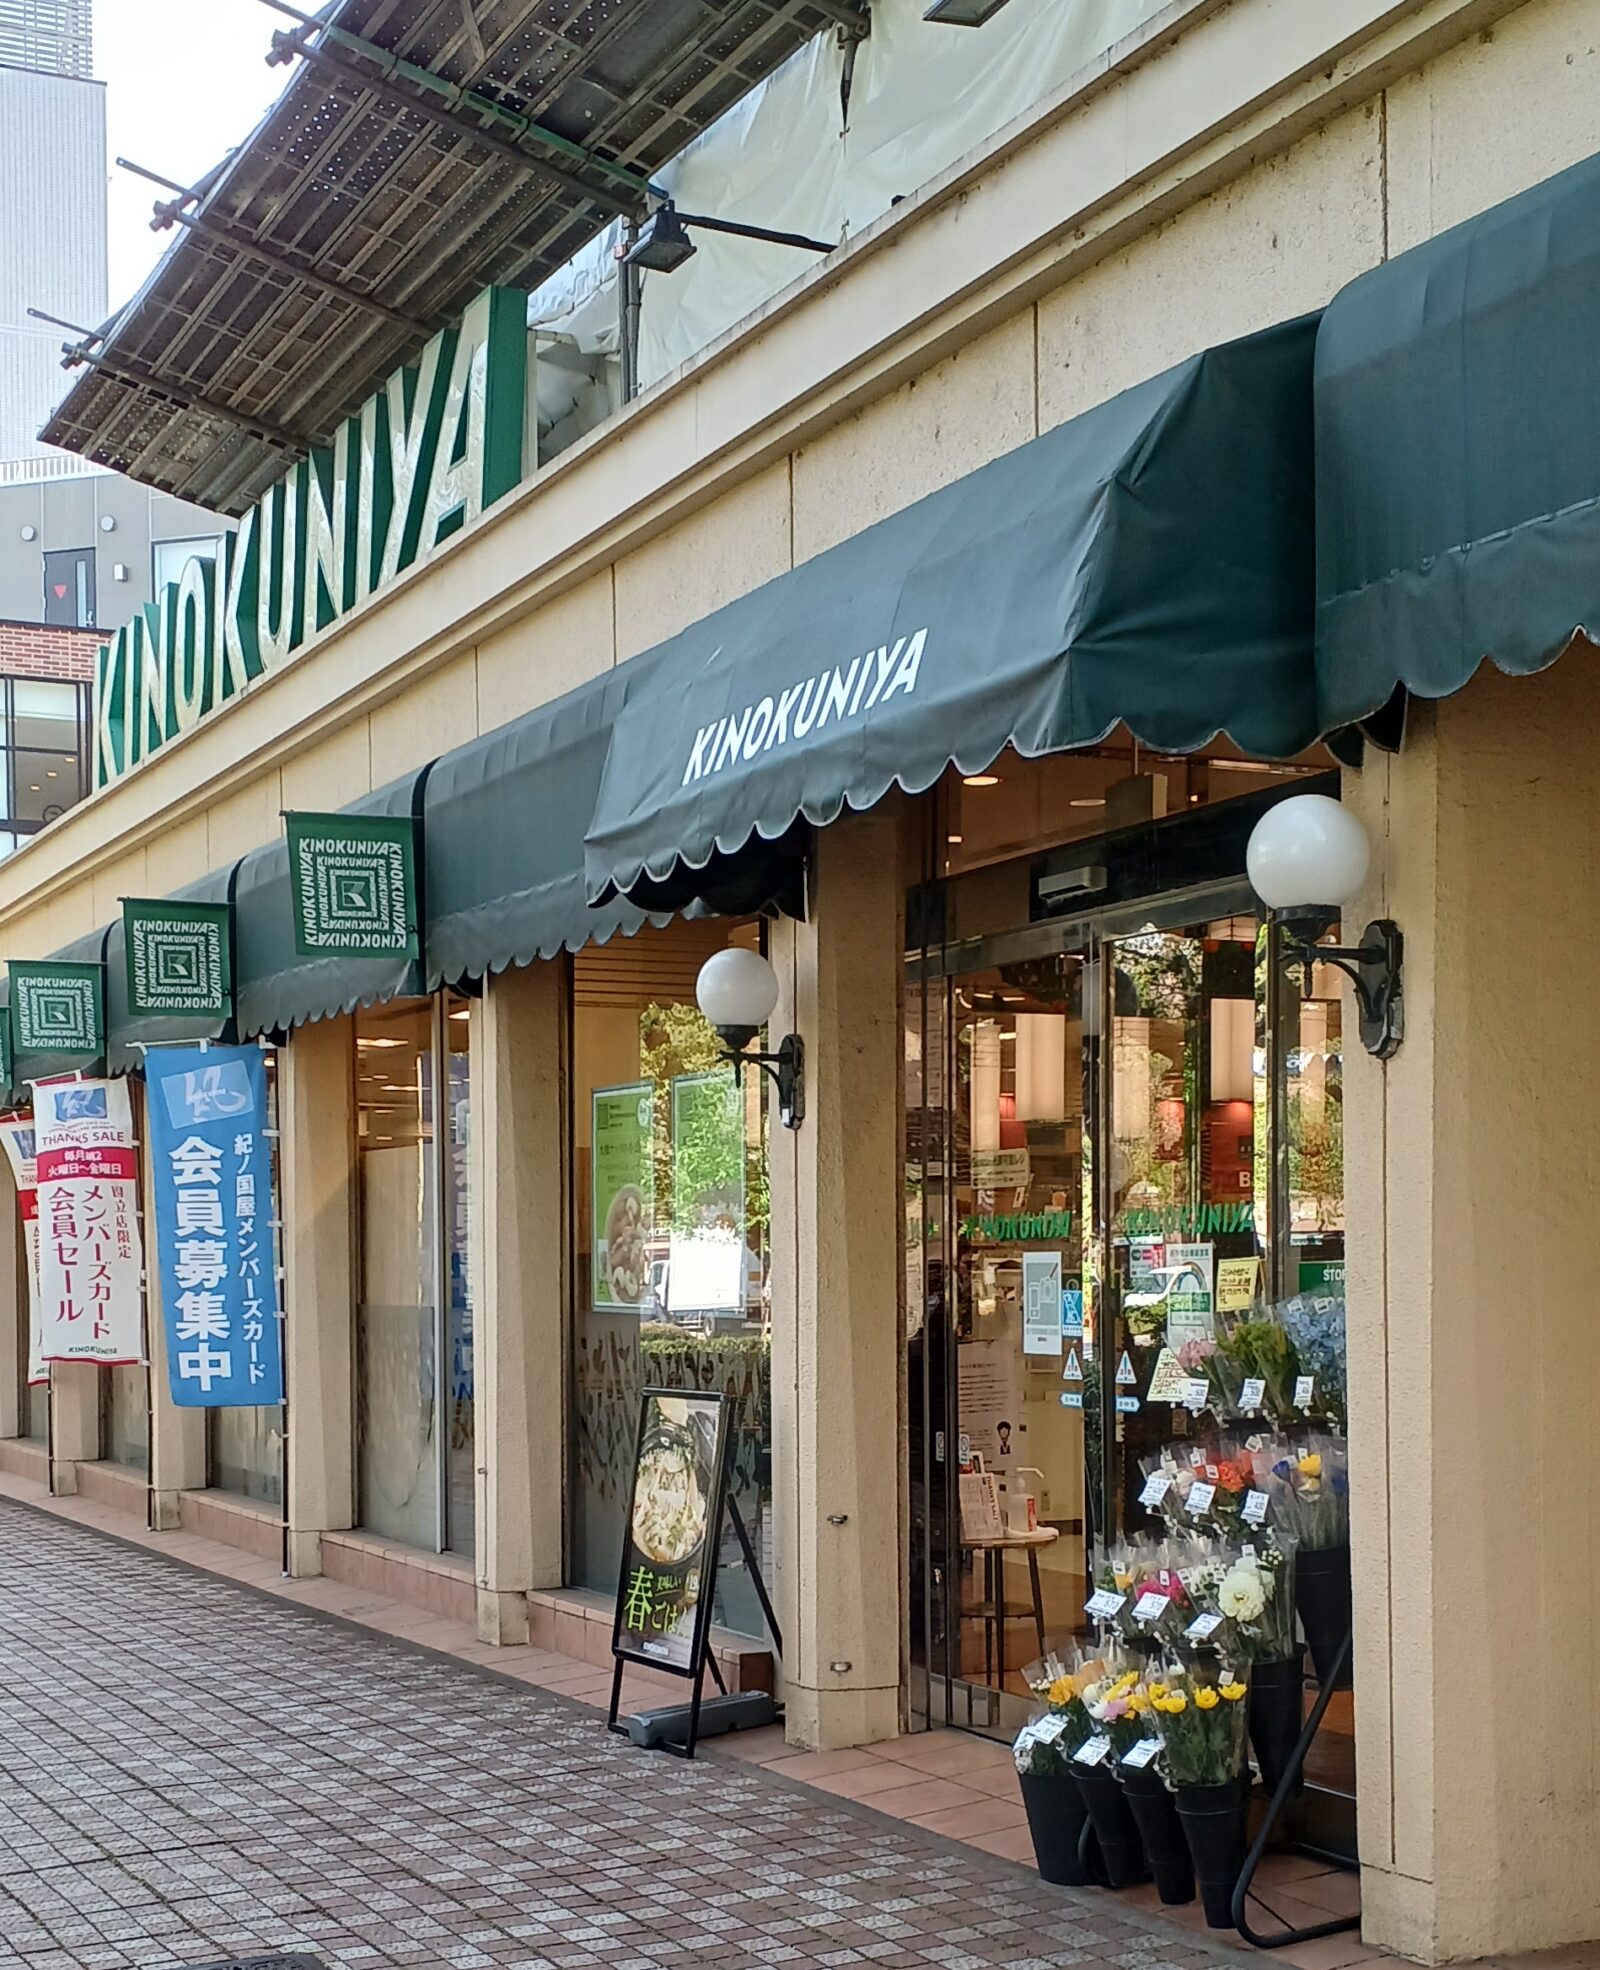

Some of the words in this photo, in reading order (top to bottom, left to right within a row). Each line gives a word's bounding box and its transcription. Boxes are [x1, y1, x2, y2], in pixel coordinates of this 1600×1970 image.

[93, 285, 512, 790] KINOKUNIYA
[682, 627, 928, 787] KINOKUNIYA
[299, 838, 390, 856] KINOKUNIYA
[300, 852, 318, 946] KINOKUNIYA
[388, 842, 406, 936] KINOKUNIYA
[133, 920, 209, 934] KINOKUNIYA
[207, 922, 222, 997] KINOKUNIYA
[317, 932, 407, 949] KINOKUNIYA
[17, 977, 84, 988] KINOKUNIYA
[133, 931, 148, 1007] KINOKUNIYA
[146, 996, 222, 1009] KINOKUNIYA
[17, 986, 33, 1047] KINOKUNIYA
[31, 1037, 96, 1049] KINOKUNIYA
[83, 979, 96, 1040] KINOKUNIYA
[41, 1132, 89, 1146] THANKS
[92, 1131, 125, 1142] SALE
[48, 1186, 85, 1323] 会員セール
[111, 1185, 131, 1259] 国立店限定
[234, 1133, 264, 1385] 紀ノ国屋メンバーズカード
[83, 1184, 111, 1340] メンバーズカード
[169, 1136, 231, 1392] 会員募集中
[623, 1565, 654, 1631] 春
